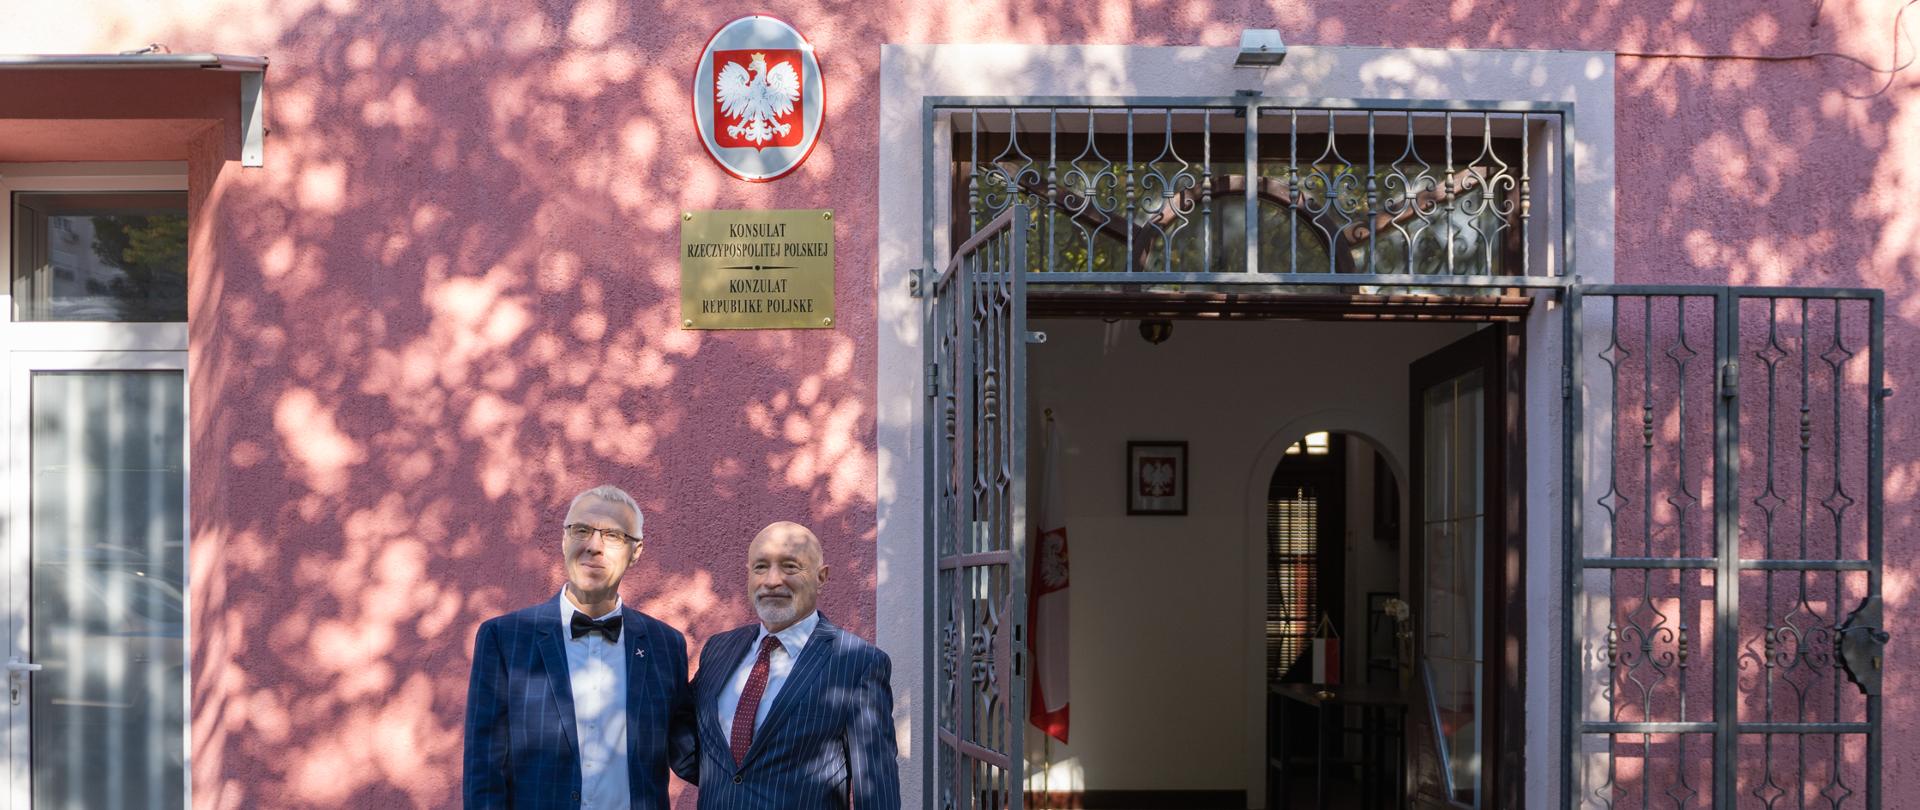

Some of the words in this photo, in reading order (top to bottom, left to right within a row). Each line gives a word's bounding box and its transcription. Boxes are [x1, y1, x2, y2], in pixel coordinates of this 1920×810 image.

[729, 223, 786, 238] KONSULAT
[687, 243, 781, 258] RZECZYPOSPOLITEJ
[784, 242, 828, 257] POLSKIEJ
[729, 278, 787, 294] KONZULAT
[702, 299, 763, 314] REPUBLIKE
[767, 298, 814, 313] POLJSKE
